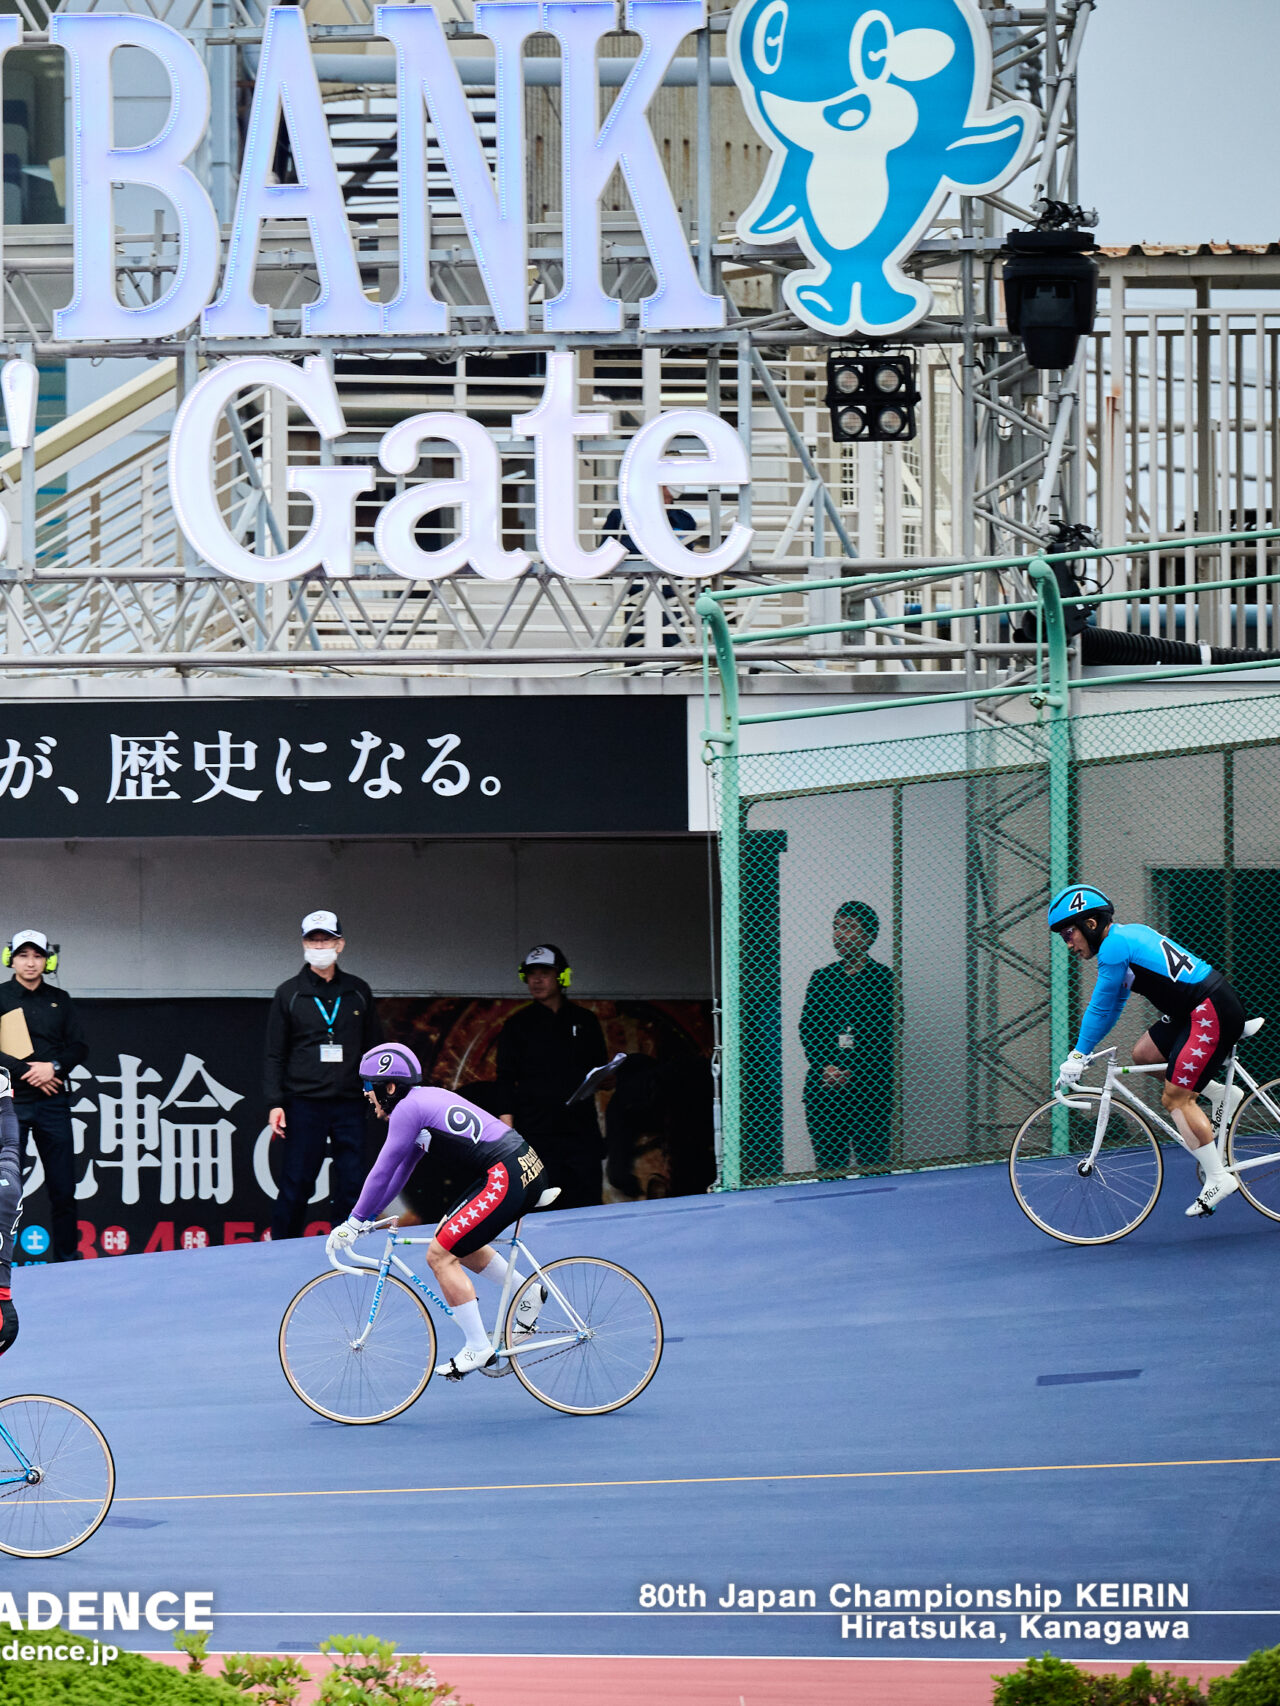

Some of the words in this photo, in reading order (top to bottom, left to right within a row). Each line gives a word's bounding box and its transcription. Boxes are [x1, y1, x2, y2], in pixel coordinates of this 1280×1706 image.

[168, 351, 755, 584] Gate
[1069, 891, 1087, 912] 4
[1160, 939, 1196, 983] 4
[376, 1053, 393, 1075] 9
[445, 1105, 483, 1144] 9
[368, 1279, 385, 1324] MAKINO
[410, 1274, 455, 1316] MAKINO
